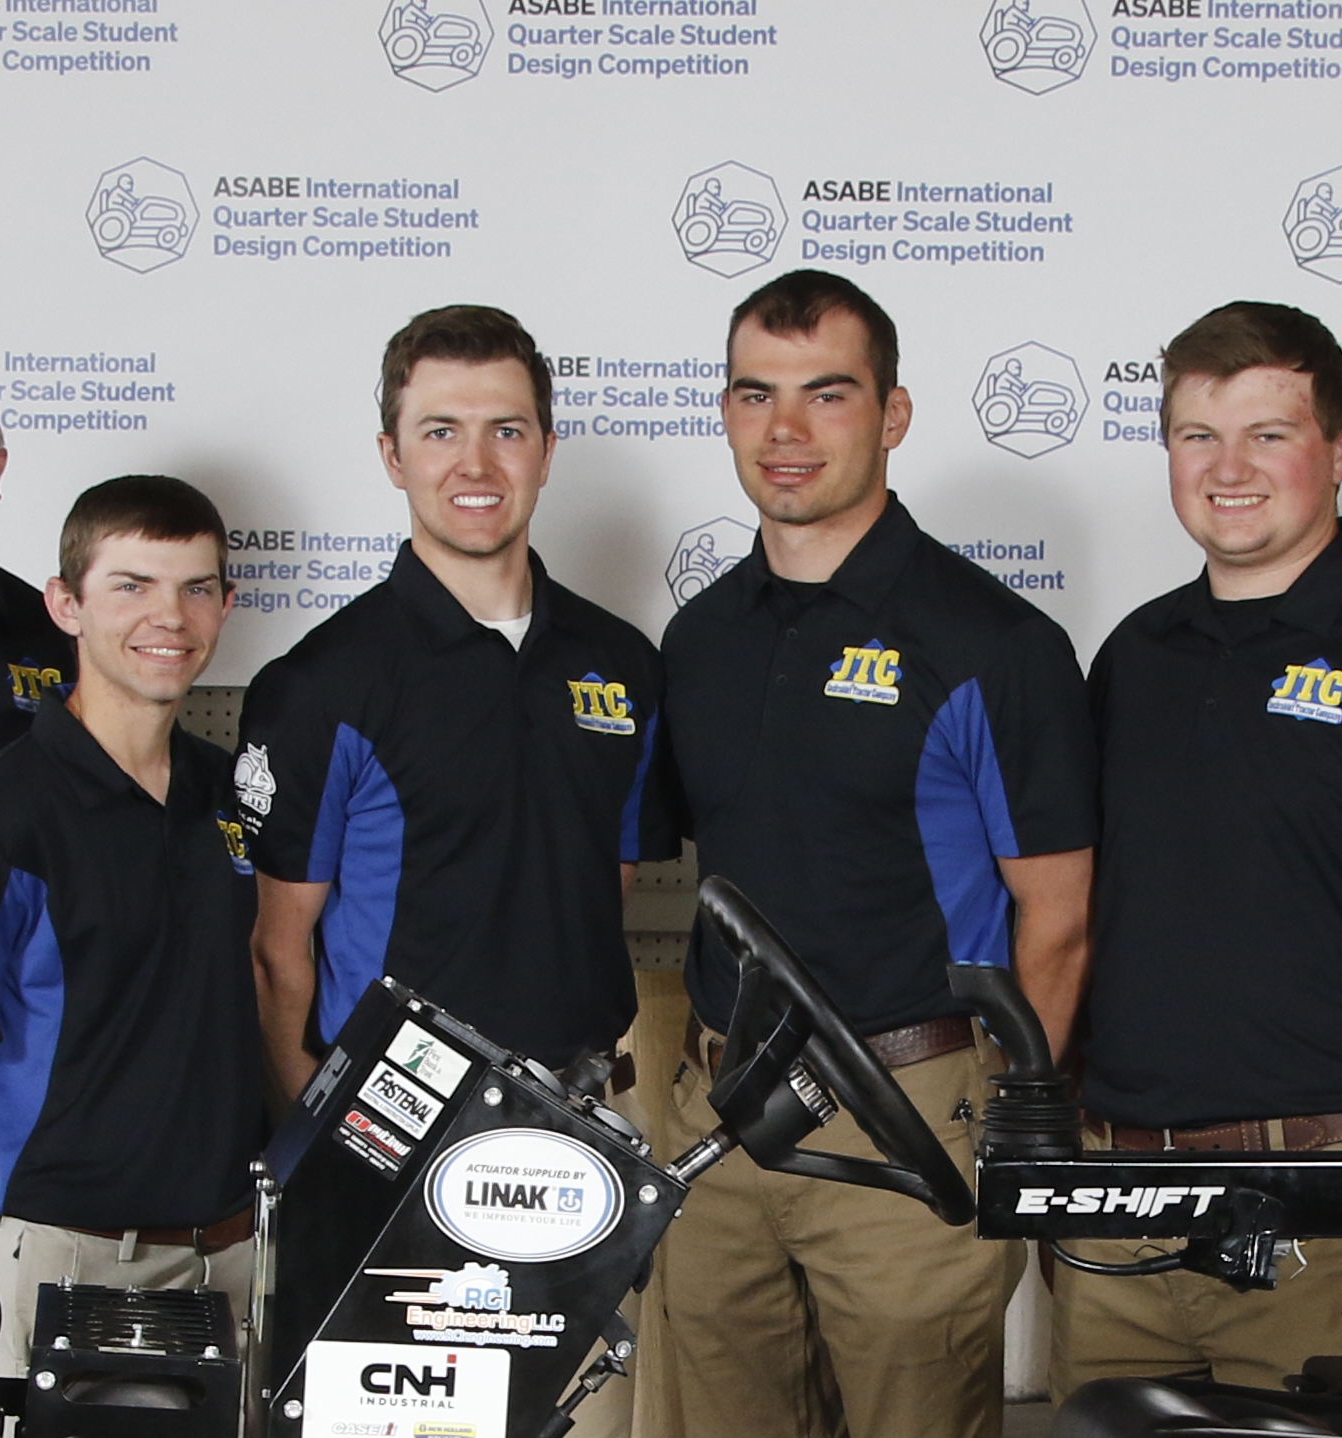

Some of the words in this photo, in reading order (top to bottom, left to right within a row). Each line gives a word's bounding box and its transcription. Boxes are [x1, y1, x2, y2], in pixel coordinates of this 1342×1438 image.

[1111, 0, 1201, 18] ASABE
[12, 21, 77, 43] Scale
[83, 22, 178, 44] Student
[507, 23, 603, 48] Quarter
[608, 24, 675, 46] Scale
[680, 25, 777, 47] Student
[1111, 26, 1208, 51] Quarter
[1214, 27, 1281, 49] Scale
[3, 50, 150, 75] Competition
[507, 53, 591, 79] Design
[598, 54, 748, 79] Competition
[1111, 56, 1196, 82] Design
[213, 176, 300, 199] ASABE
[307, 177, 458, 200] International
[802, 180, 891, 203] ASABE
[897, 181, 1052, 204] International
[213, 206, 307, 230] Quarter
[313, 207, 378, 229] Scale
[384, 207, 478, 229] Student
[802, 210, 898, 234] Quarter
[903, 211, 970, 233] Scale
[975, 211, 1073, 233] Student
[213, 235, 296, 260] Design
[303, 236, 450, 261] Competition
[802, 239, 886, 265] Design
[892, 240, 1044, 266] Competition
[5, 351, 156, 373] International
[597, 357, 727, 378] Internation
[1104, 361, 1162, 383] ASA
[10, 380, 76, 402] Scale
[81, 381, 176, 402] Student
[552, 386, 597, 406] rter
[602, 386, 669, 407] Scale
[1, 408, 147, 434] Competition
[592, 414, 728, 440] Competitio
[228, 530, 295, 550] SABE
[228, 560, 301, 581] uarter
[307, 560, 372, 581] Scale
[232, 589, 291, 613] esign
[833, 647, 900, 686] JTC
[567, 680, 627, 718] JTC
[371, 1069, 434, 1125] FASTENAL
[465, 1163, 520, 1176] ACTUATOR
[522, 1167, 570, 1180] SUPPLIED
[573, 1171, 587, 1181] BY
[465, 1180, 550, 1212] LINAK
[1014, 1186, 1226, 1219] E-SHIFT
[464, 1210, 479, 1219] WE
[482, 1211, 527, 1223] IMPROVE
[530, 1215, 557, 1225] YOUR
[559, 1218, 582, 1227] LIFE
[464, 1287, 509, 1311] RCI
[359, 1397, 455, 1410] INDUSTRIAL
